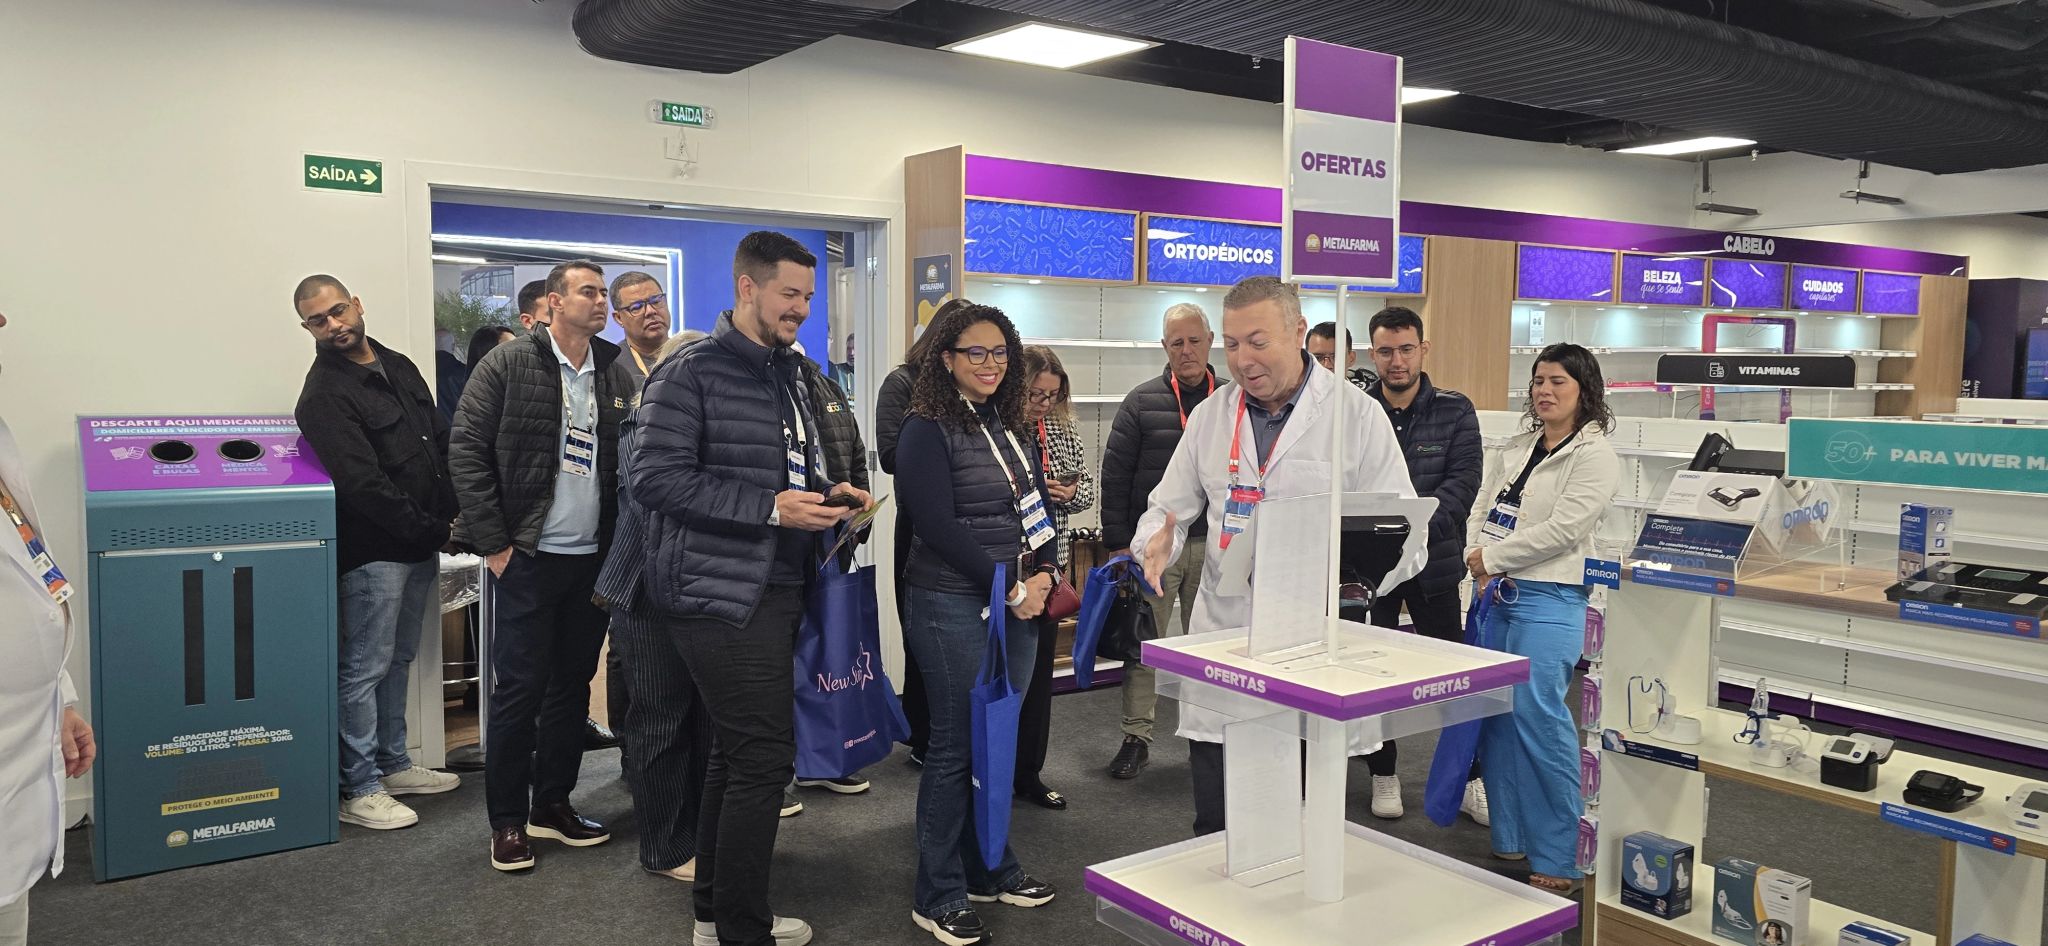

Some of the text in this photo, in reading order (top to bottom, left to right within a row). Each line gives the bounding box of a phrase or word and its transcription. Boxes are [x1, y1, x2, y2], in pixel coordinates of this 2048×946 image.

[672, 105, 702, 123] SAÍDA
[308, 165, 357, 183] SAÍDA
[1301, 151, 1386, 179] OFERTAS
[1323, 236, 1380, 252] METALFARMA
[1724, 235, 1775, 255] CABELO
[1163, 242, 1274, 265] ORTOPÉDICOS
[1643, 270, 1682, 284] BELEZA
[1640, 284, 1656, 299] que
[1802, 280, 1844, 294] CUIDADOS
[1738, 366, 1800, 376] VITAMINAS
[90, 420, 162, 428] DESCARTE
[1890, 448, 1949, 465] PARA
[1953, 452, 2022, 470] VIVER
[1651, 522, 1684, 533] Complete
[1586, 568, 1619, 580] OMRON
[1905, 602, 1928, 610] OMRON
[817, 672, 850, 692] New
[1204, 665, 1266, 694] OFERTAS
[1412, 676, 1471, 700] OFERTAS
[148, 729, 290, 752] DE RESÍDUOS POR DISPENSADOR:
[172, 726, 266, 743] CAPACIDADE MÁXIMA
[144, 749, 185, 759] VOLUME:
[186, 746, 198, 754] 50
[200, 742, 230, 752] LITROS
[238, 738, 270, 747] MASSA:
[272, 734, 293, 743] 30KG
[168, 802, 202, 812] PROTEGE
[213, 797, 233, 805] MEIO
[235, 791, 274, 802] AMBIENTE
[193, 817, 275, 840] METALFARMA
[1718, 868, 1741, 879] OMRON
